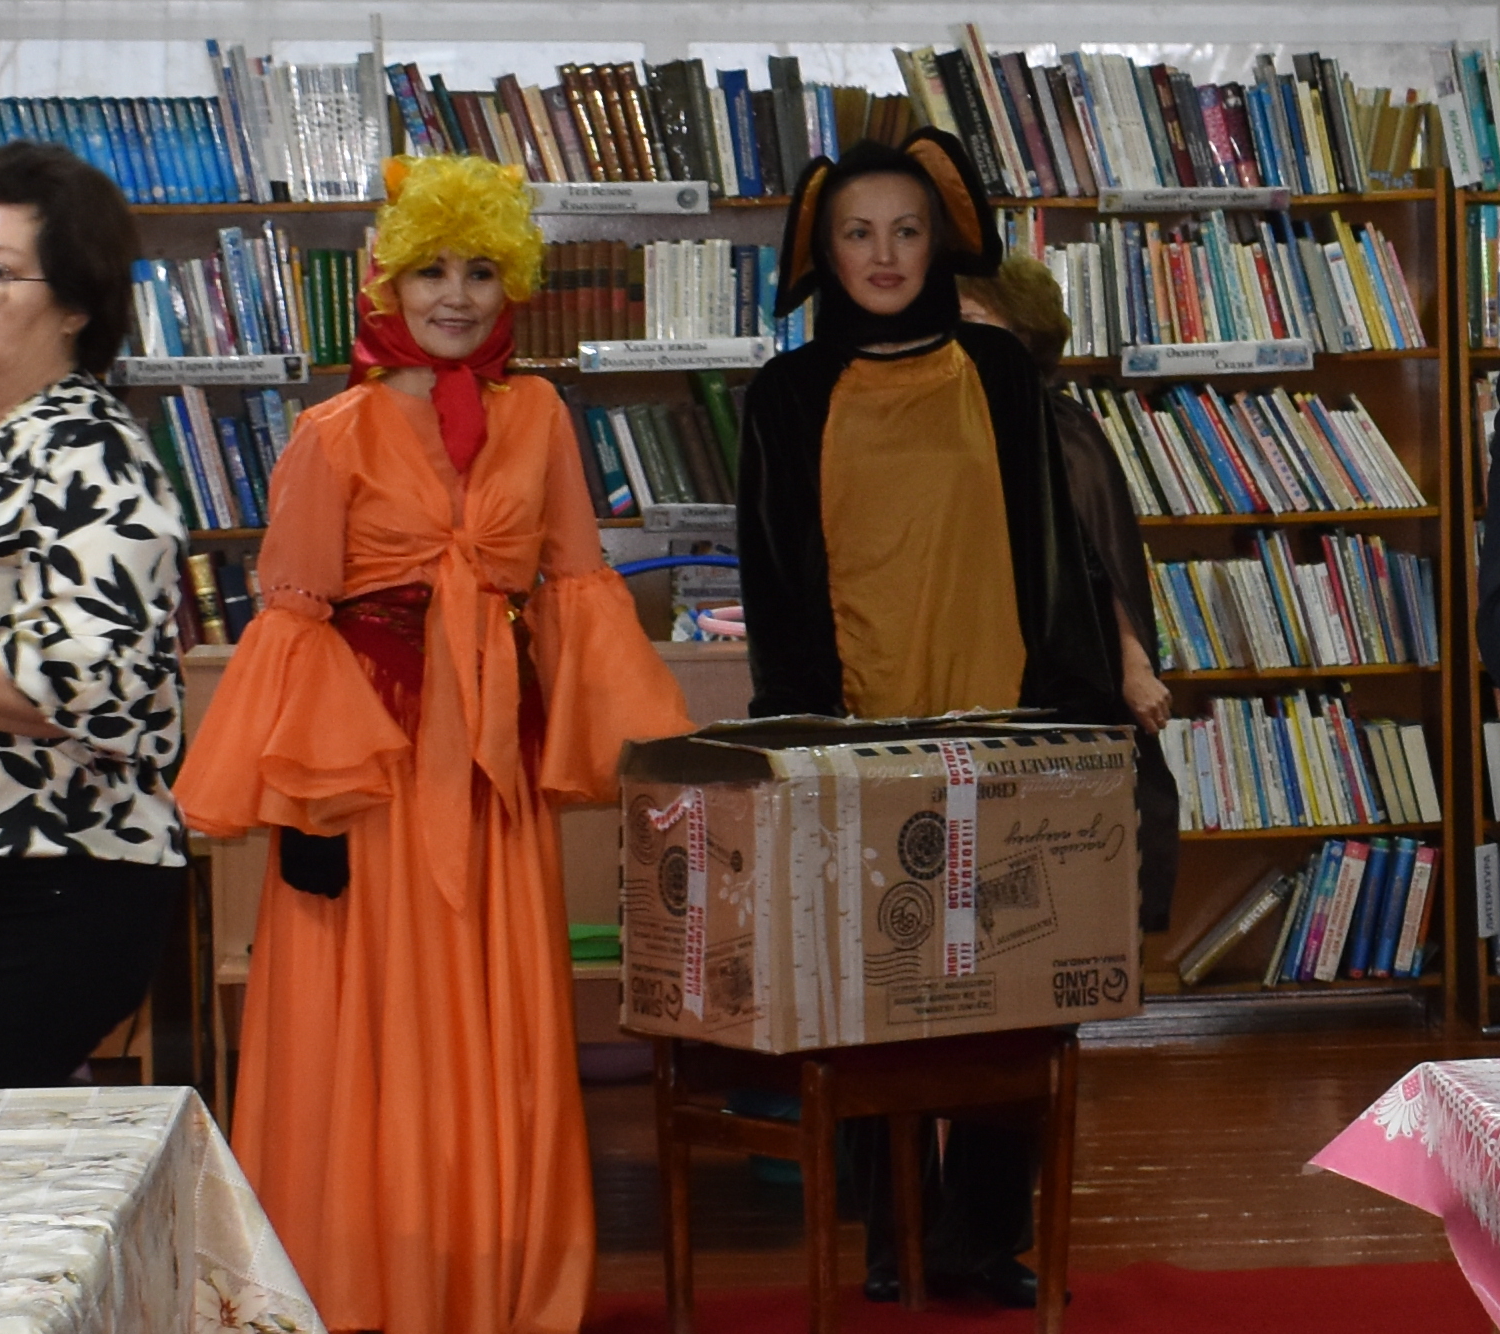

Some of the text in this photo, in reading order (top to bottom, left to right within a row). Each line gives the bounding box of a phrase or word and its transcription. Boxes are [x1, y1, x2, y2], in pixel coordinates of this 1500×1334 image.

[948, 819, 959, 909] ОСТОРОЖНО!!!
[1053, 969, 1099, 989] LAND
[1053, 987, 1099, 1009] SIMA
